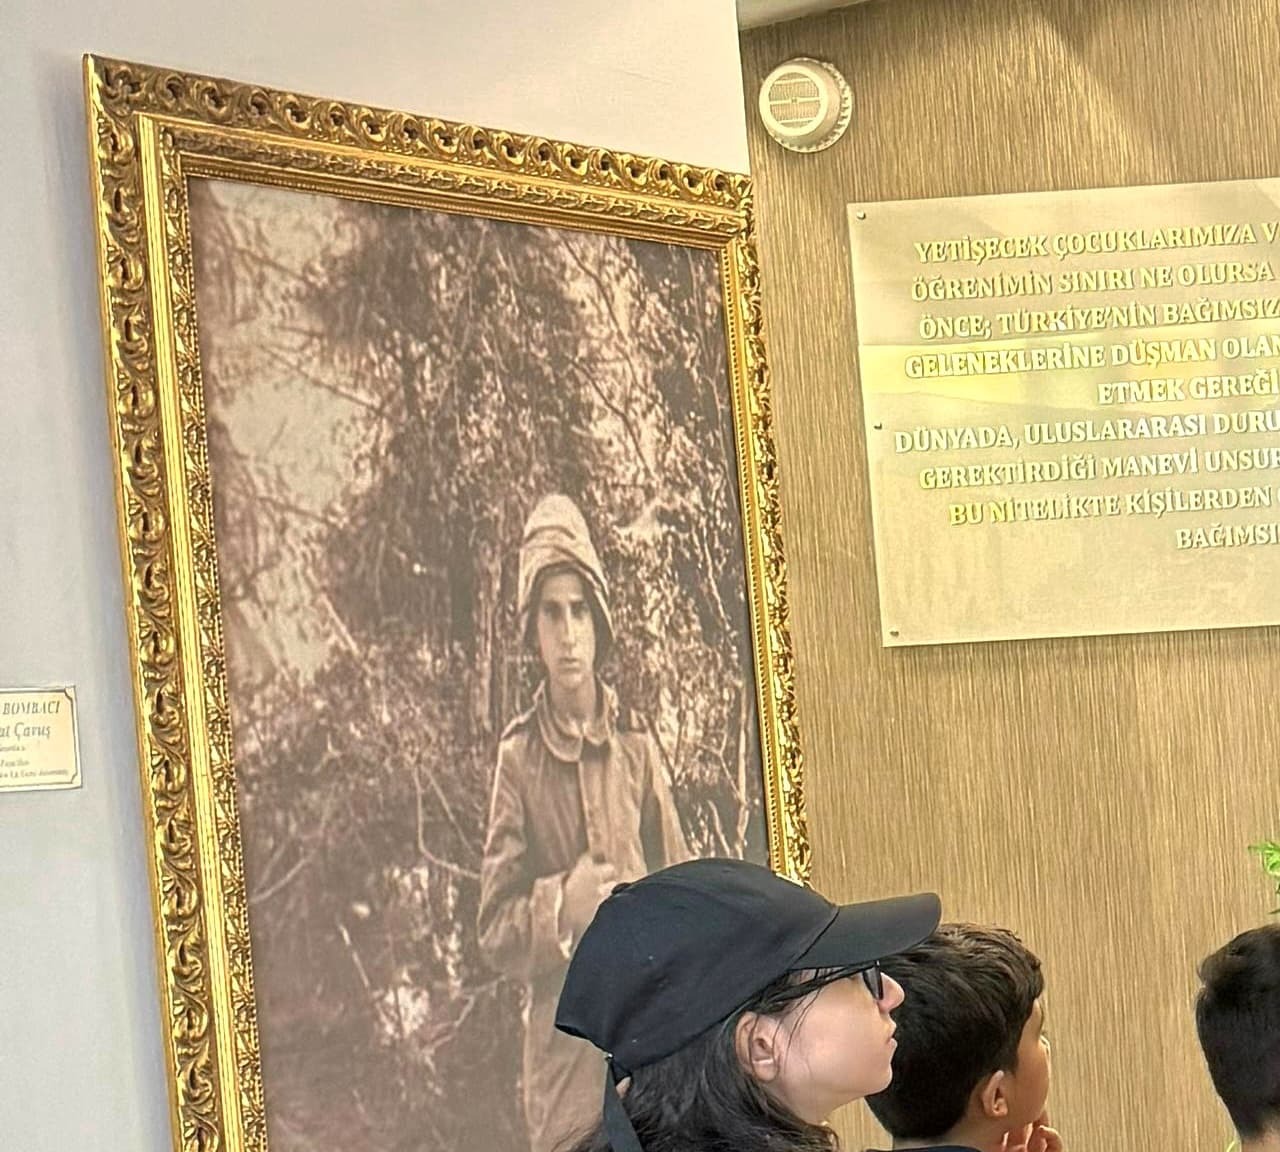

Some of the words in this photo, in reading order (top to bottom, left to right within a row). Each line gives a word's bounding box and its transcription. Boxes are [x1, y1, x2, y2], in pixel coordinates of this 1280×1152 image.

[914, 234, 1048, 265] YETİŞECEK
[1053, 223, 1256, 261] ÇOCUKLARIMIZA
[911, 271, 1053, 302] ÖĞRENİMİN
[1058, 268, 1134, 293] SINIRI
[1140, 266, 1173, 289] NE
[1178, 260, 1273, 286] OLURSA
[919, 314, 992, 341] ÖNCE;
[999, 302, 1157, 335] TÜRKİYE'NİN
[905, 344, 1105, 379] GELENEKLERİNE
[1111, 337, 1216, 368] DÜŞMAN
[1097, 378, 1185, 406] ETMEK
[1189, 370, 1279, 402] GEREĞİ
[894, 427, 1021, 454] DÜNYADA,
[1024, 414, 1207, 446] ULUSLARARASI
[918, 455, 1097, 490] GEREKTİRDİĞİ
[1101, 448, 1198, 478] MANEVİ
[948, 503, 984, 526] BU
[988, 492, 1121, 523] NİTELİKTE
[1126, 484, 1272, 519] KİŞİLERDEN
